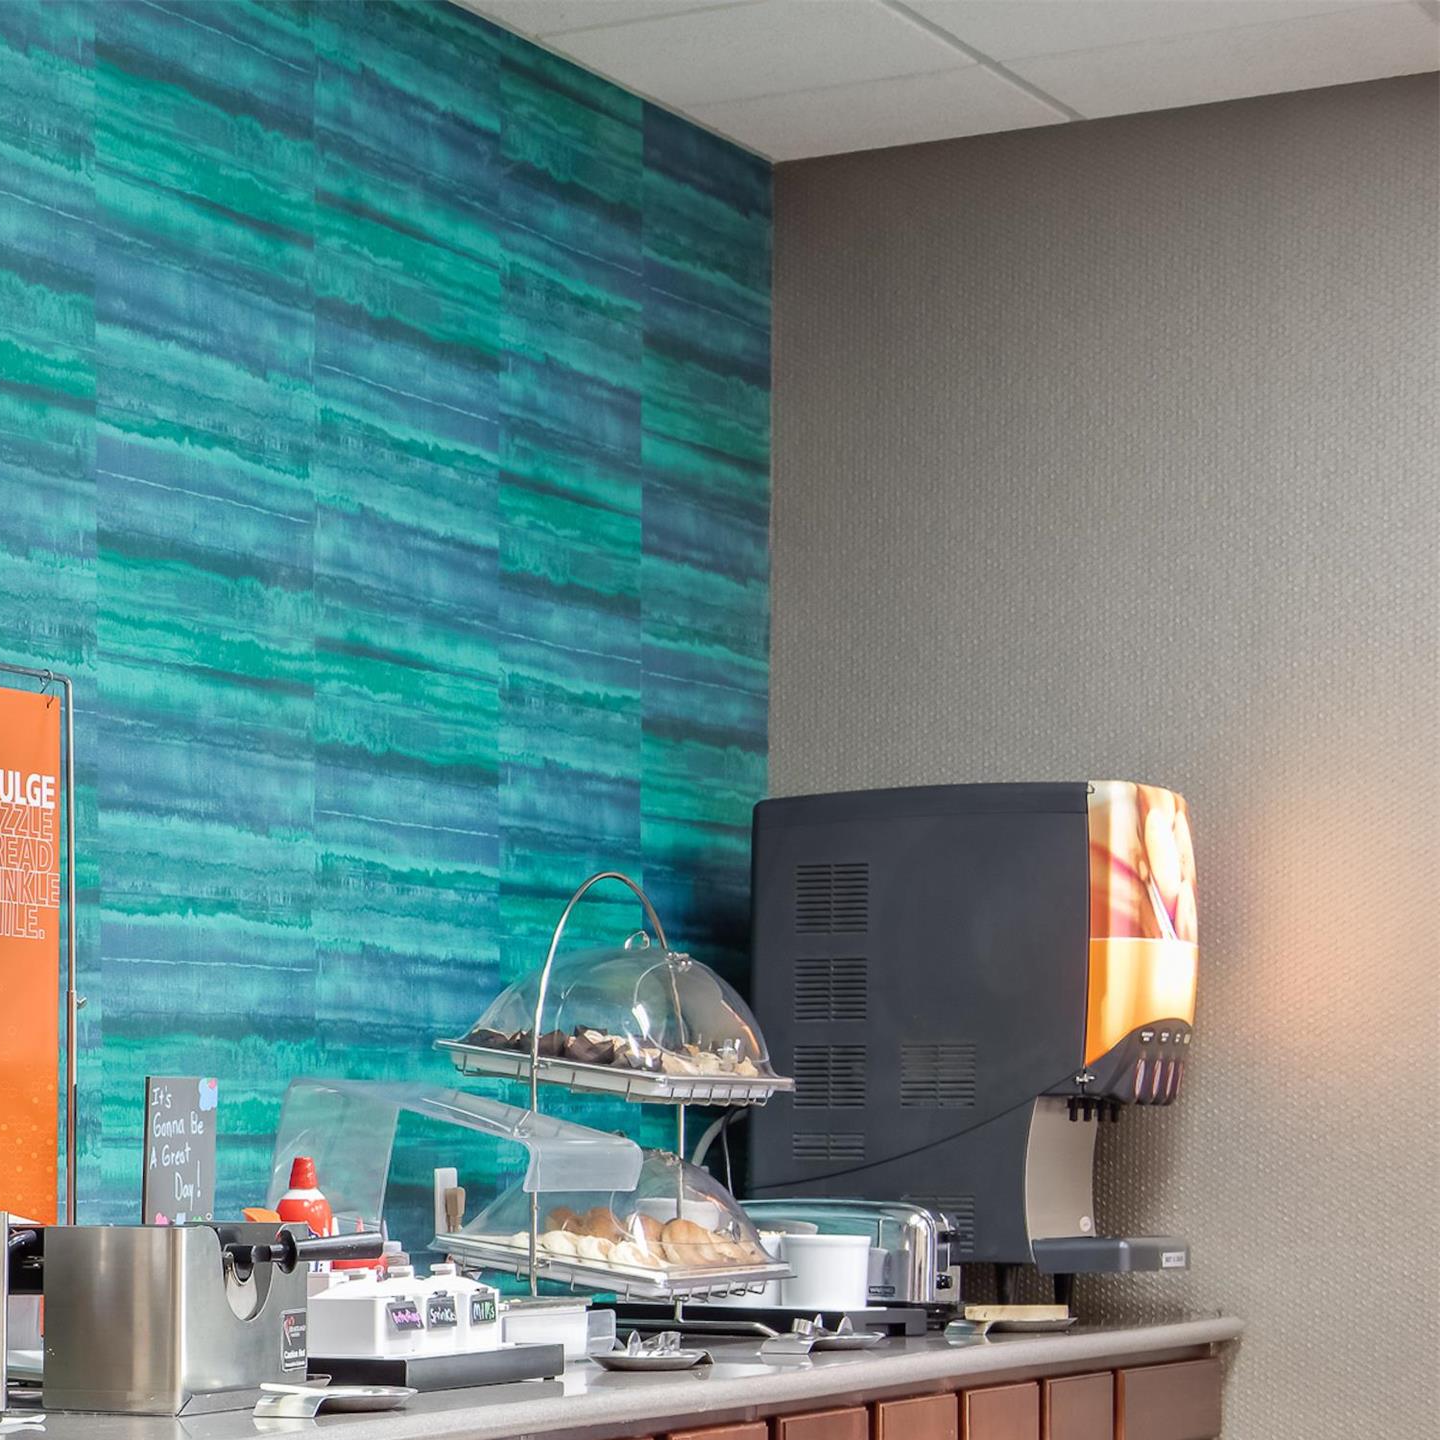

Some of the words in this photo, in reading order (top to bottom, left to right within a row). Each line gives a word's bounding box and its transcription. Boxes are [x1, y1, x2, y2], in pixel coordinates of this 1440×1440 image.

[151, 1085, 172, 1109] It's
[153, 1112, 185, 1138] Gonna
[190, 1110, 204, 1135] Be
[150, 1146, 158, 1170] A
[162, 1142, 191, 1166] Great
